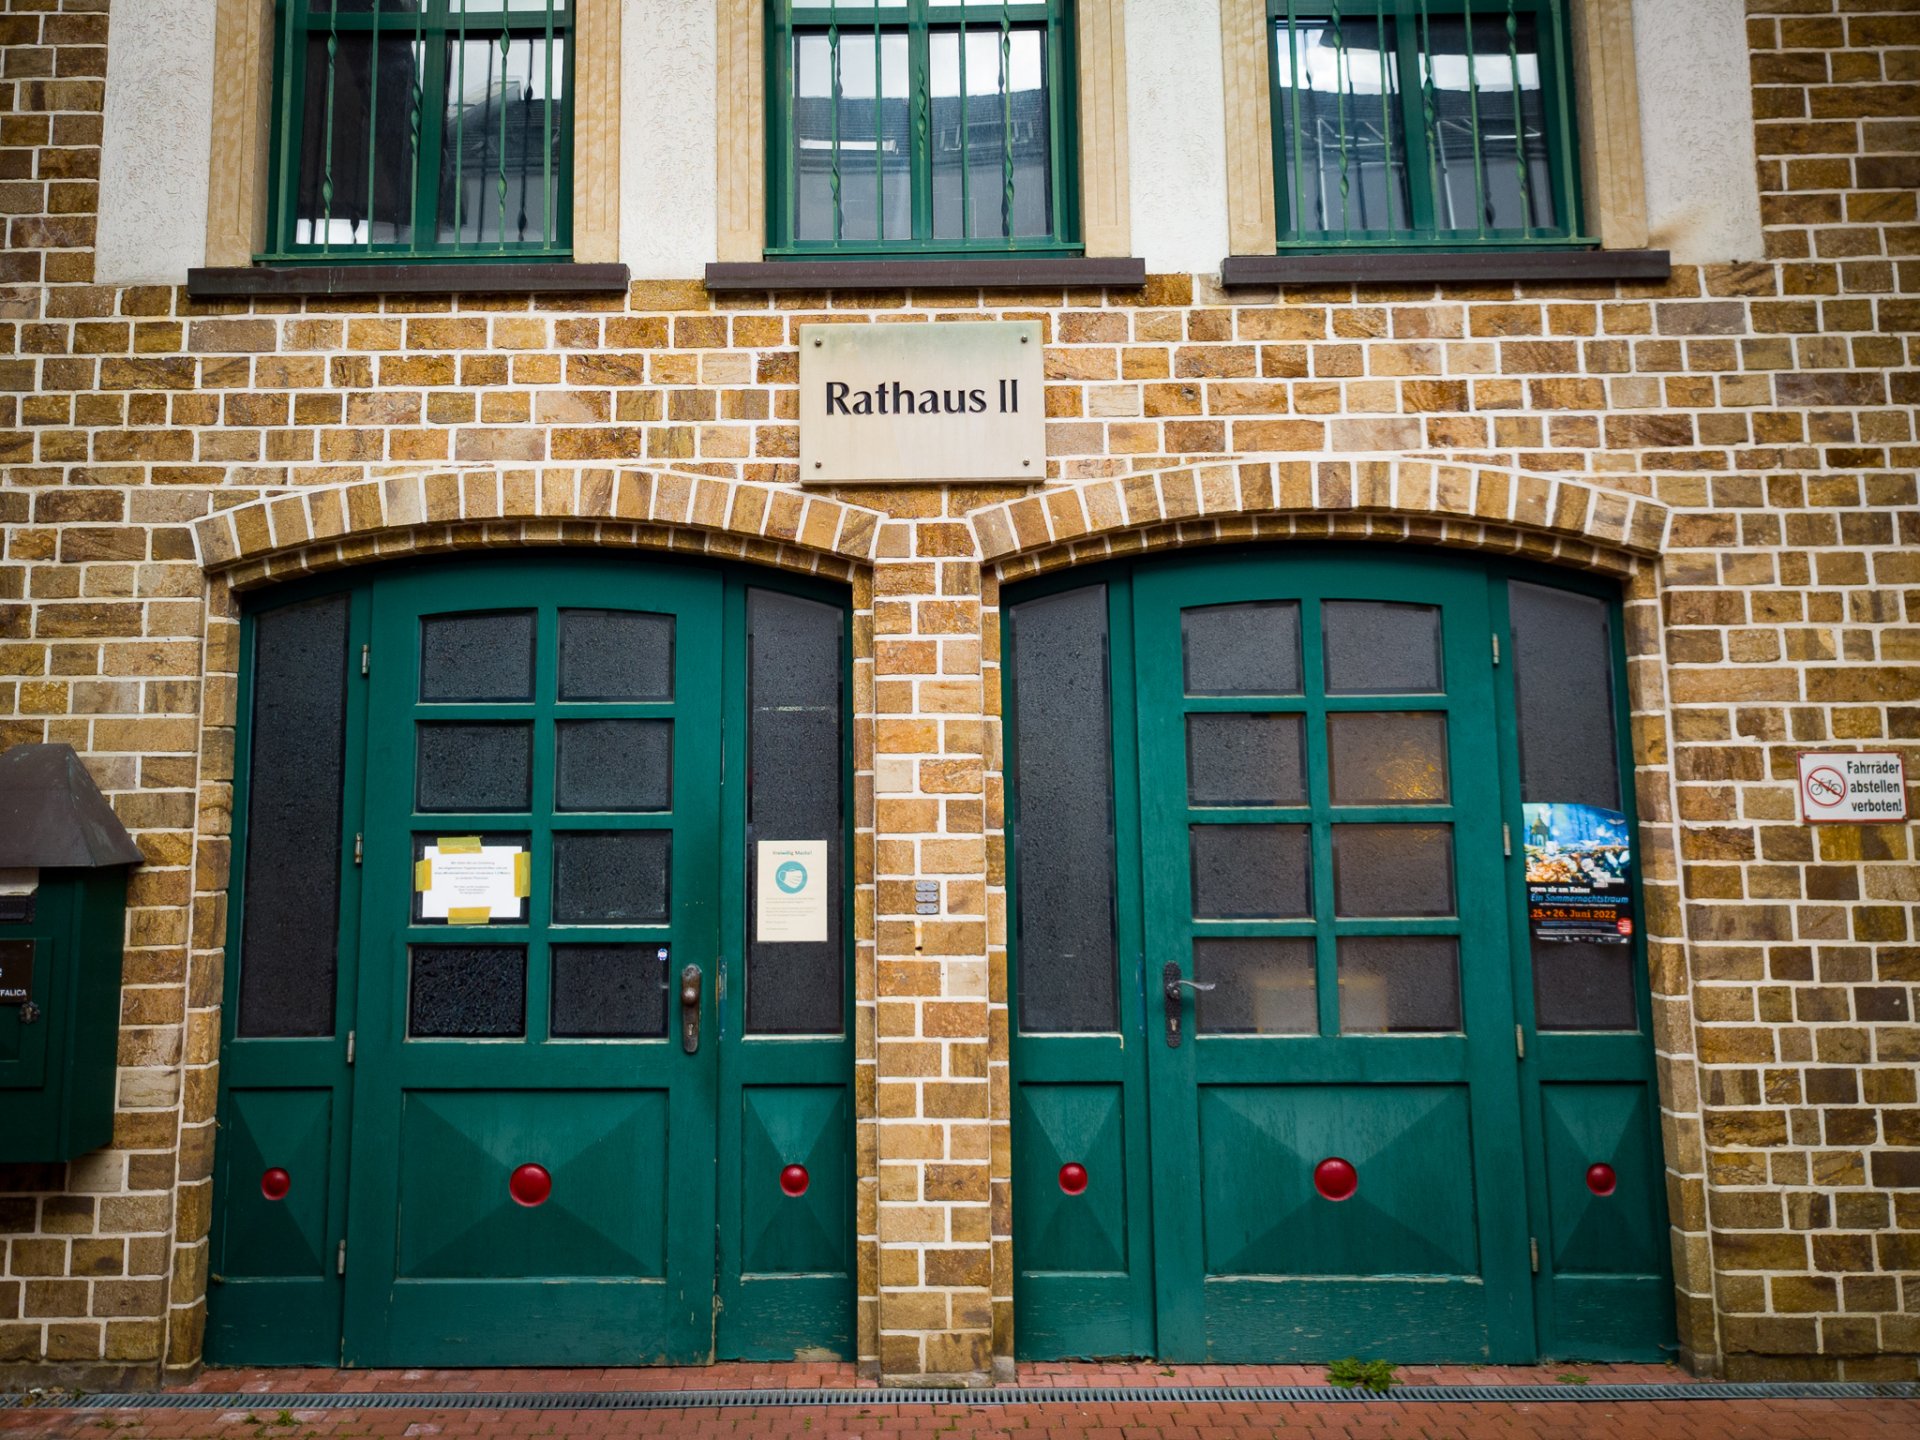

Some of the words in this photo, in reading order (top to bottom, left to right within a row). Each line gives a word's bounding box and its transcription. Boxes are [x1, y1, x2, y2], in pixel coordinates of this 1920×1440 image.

[825, 381, 987, 416] Rathaus
[998, 379, 1019, 413] II
[1846, 761, 1900, 774] Fahrräder
[1850, 780, 1900, 793] abstellen
[1851, 798, 1903, 812] verboten!
[1530, 893, 1544, 902] Ein
[1545, 894, 1629, 904] Sommernachtstraum
[1569, 909, 1592, 918] Juni
[1593, 910, 1617, 919] 2022
